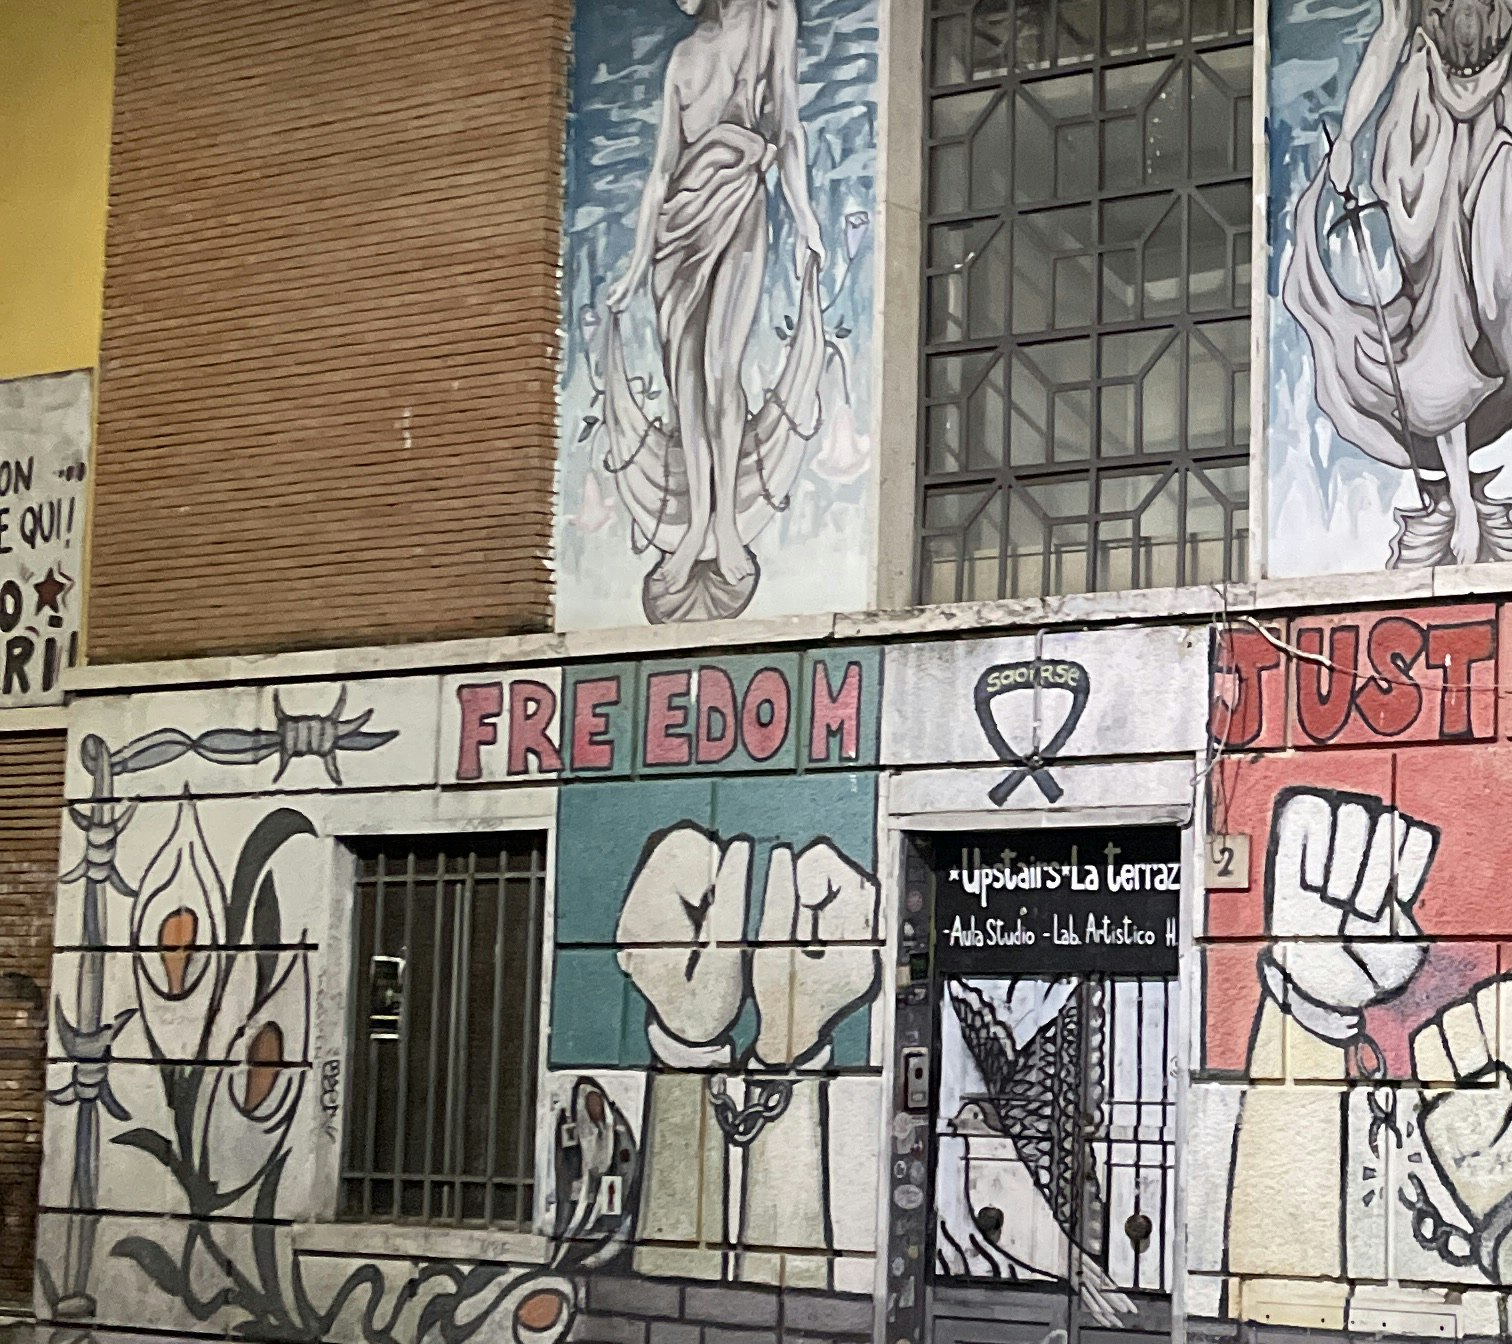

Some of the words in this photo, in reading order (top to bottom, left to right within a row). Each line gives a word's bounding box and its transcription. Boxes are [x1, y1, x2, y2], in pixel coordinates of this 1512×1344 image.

[456, 659, 864, 781] FREEDOM
[1214, 846, 1236, 878] 2
[985, 909, 1036, 947] Studio
[1085, 911, 1156, 947] Artistico
